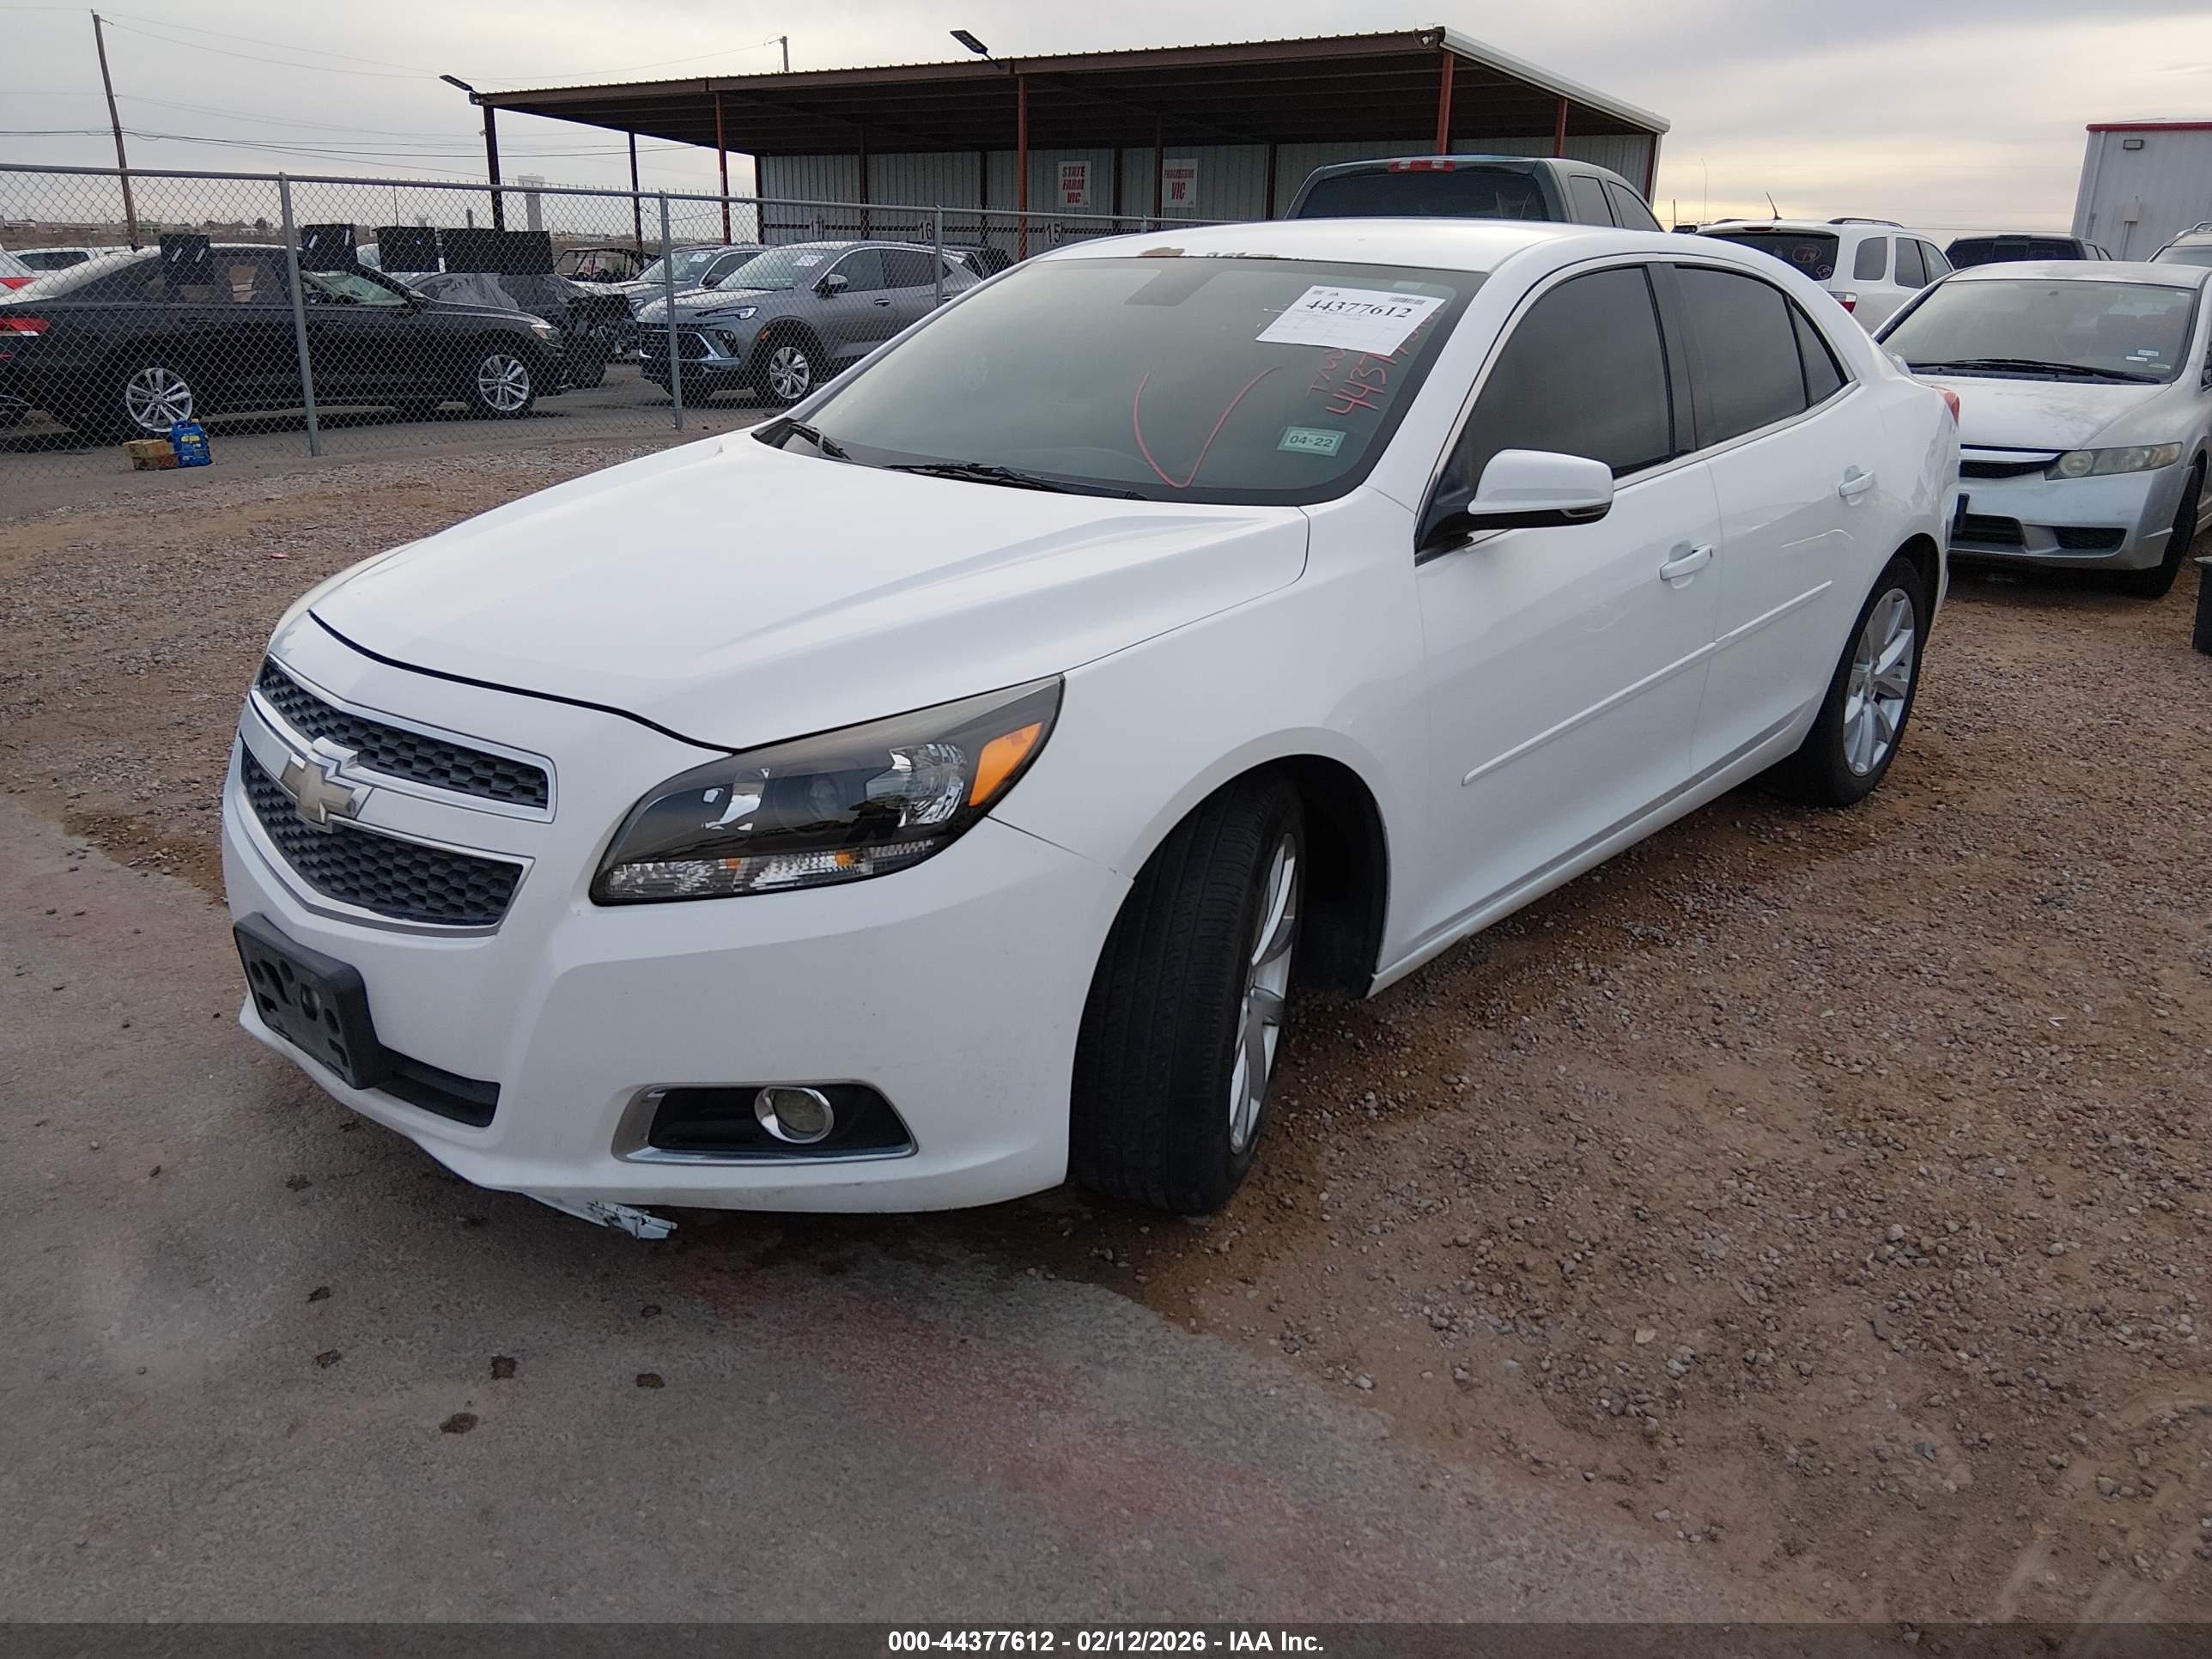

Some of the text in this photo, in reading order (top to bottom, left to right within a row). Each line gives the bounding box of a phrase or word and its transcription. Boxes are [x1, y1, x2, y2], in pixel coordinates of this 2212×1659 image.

[1062, 166, 1085, 178] STATE
[1062, 179, 1085, 190] FARM
[1171, 181, 1186, 199] VIC
[1067, 191, 1081, 204] VIC
[919, 220, 933, 240] 16
[1046, 223, 1061, 243] 15
[1306, 300, 1413, 319] 44377612
